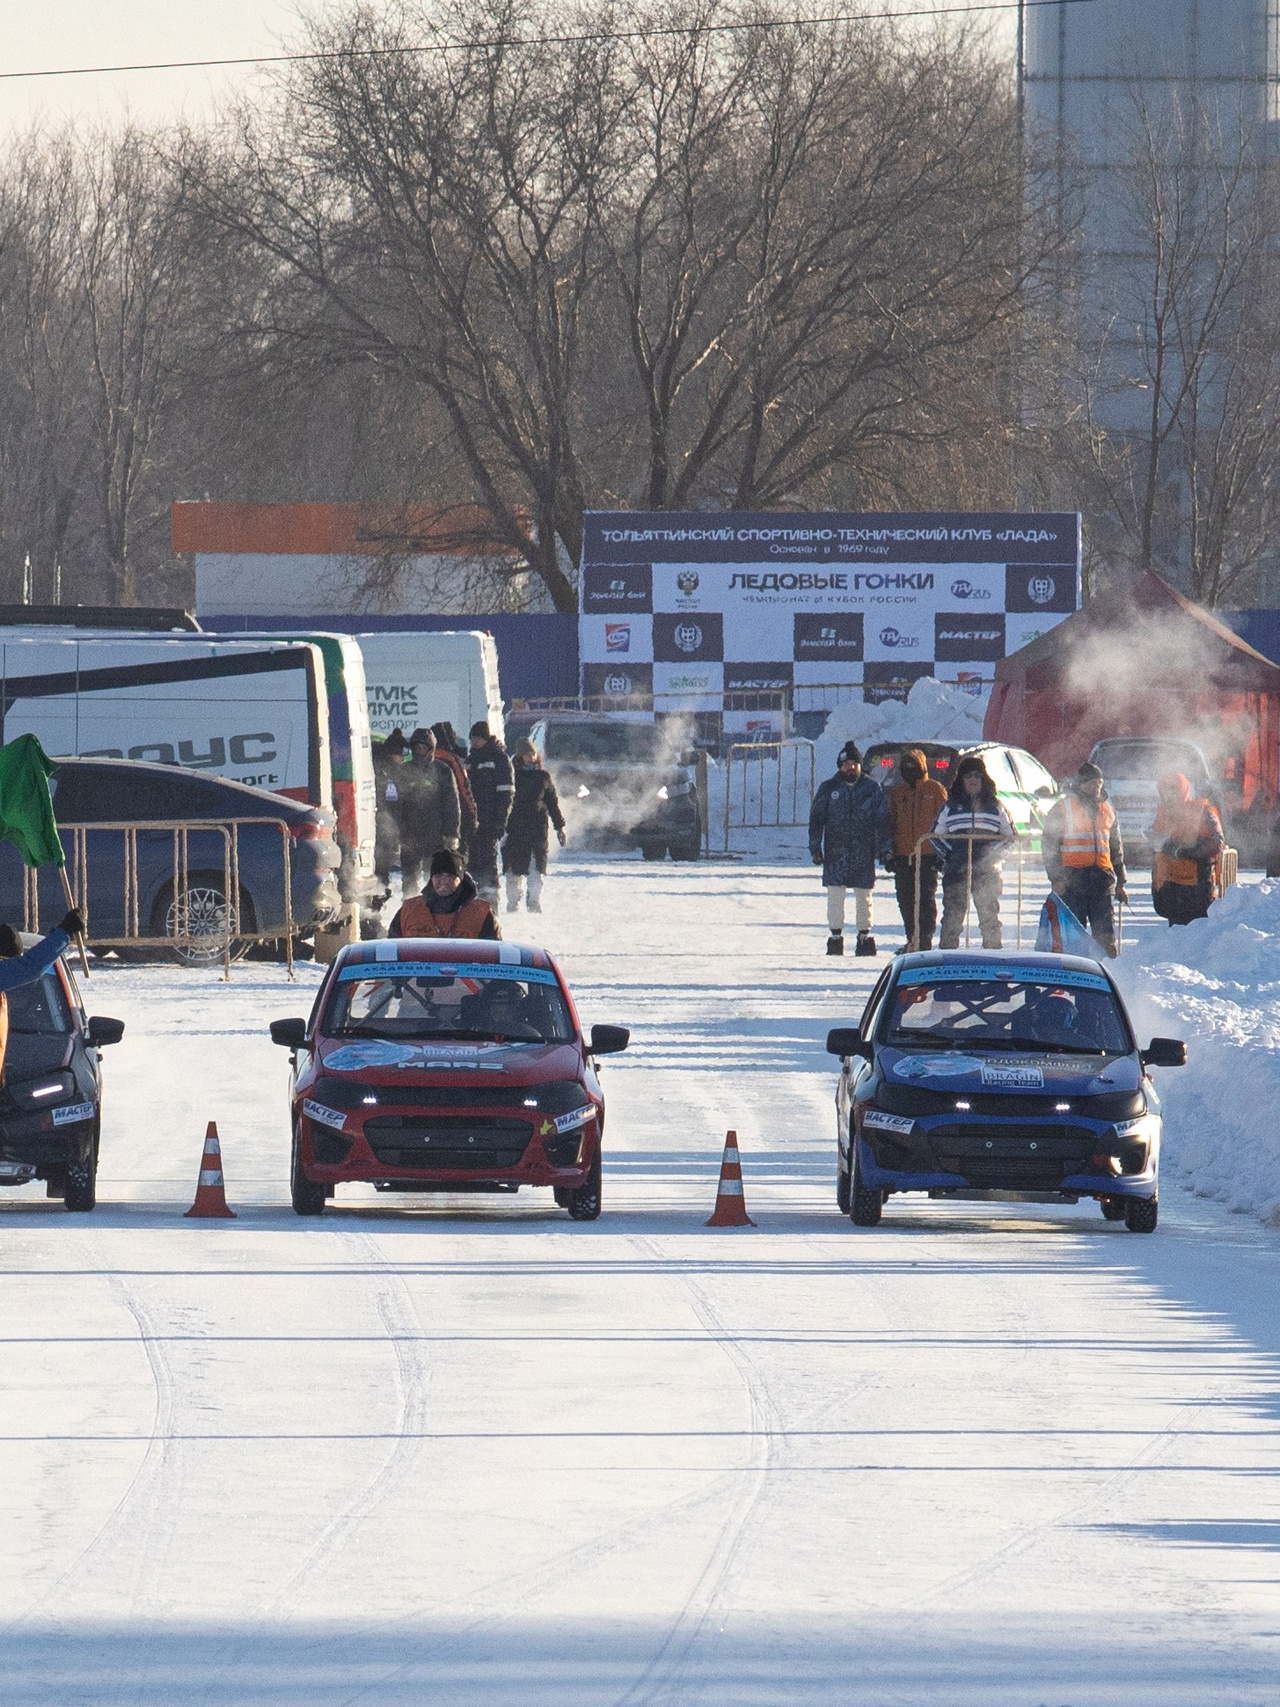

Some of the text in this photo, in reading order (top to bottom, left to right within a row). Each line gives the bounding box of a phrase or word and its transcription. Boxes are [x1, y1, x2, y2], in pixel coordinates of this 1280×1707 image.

[602, 527, 1058, 543] ТОЛЬЯТТИНСКИЙ СПОРТИВНО-ТЕХНИЧЕСКИЙ КЛУБ «ЛАДА»
[770, 544, 817, 554] Основан
[838, 545, 863, 554] 1969
[728, 573, 934, 592] ЛЕДОВЫЕ ГОНКИ
[939, 630, 1001, 640] МАСТЕР
[728, 680, 789, 689] МАСТЕР
[371, 719, 419, 730] РСПОРТ
[986, 1072, 1039, 1081] BRAGIN
[55, 1103, 92, 1118] МАСТЕР
